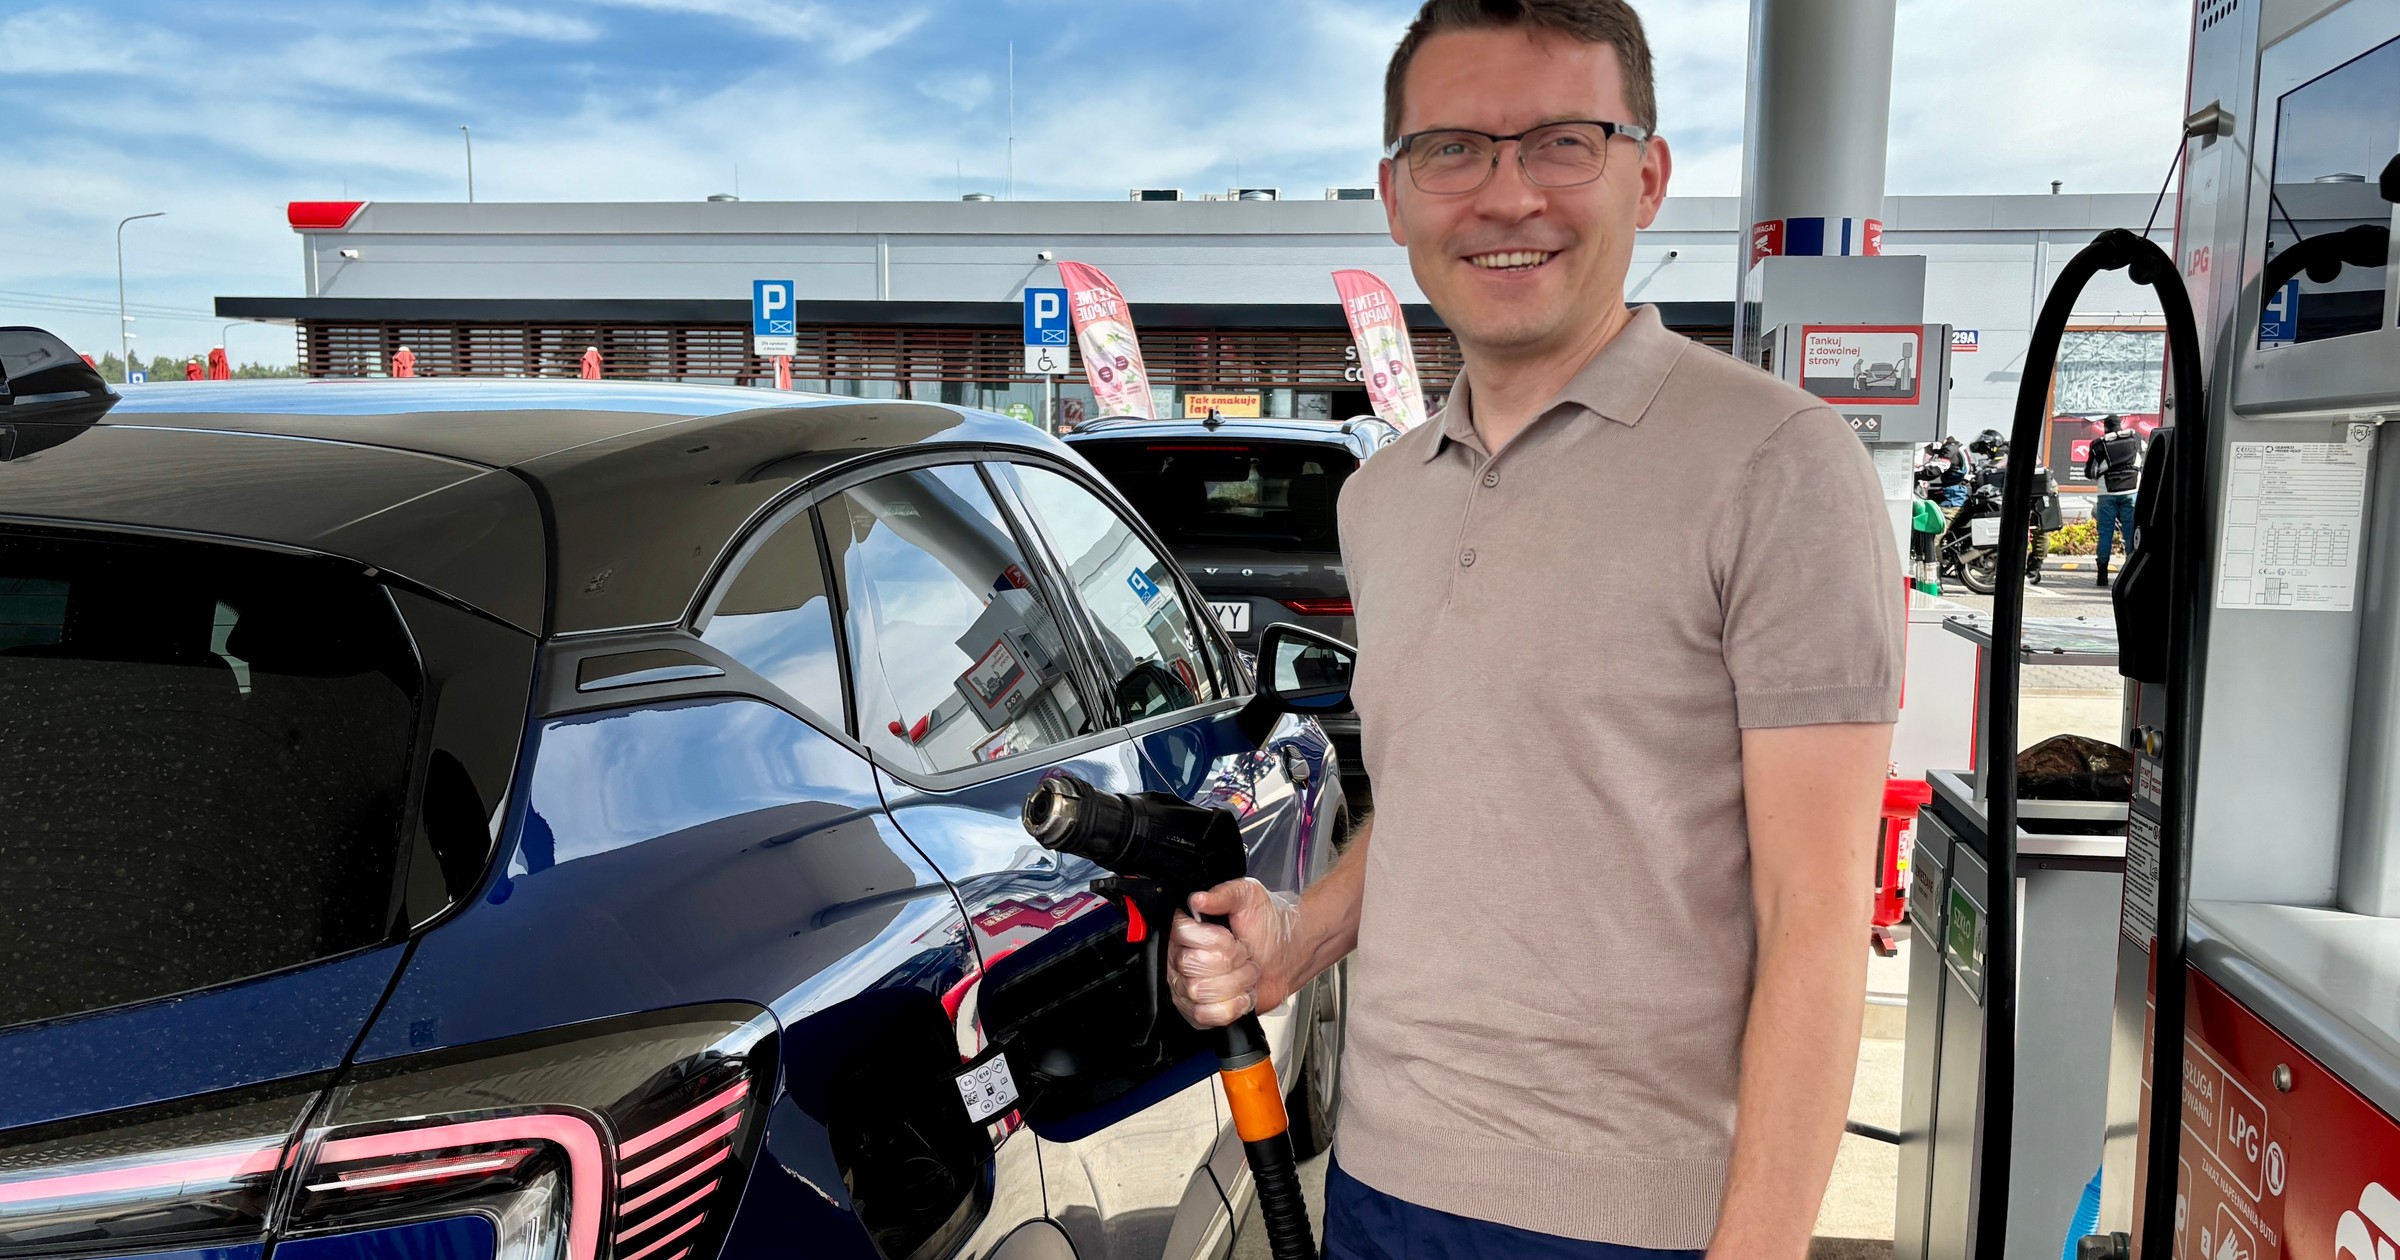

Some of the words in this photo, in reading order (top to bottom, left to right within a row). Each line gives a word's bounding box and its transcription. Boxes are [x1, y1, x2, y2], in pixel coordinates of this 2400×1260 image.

[1753, 223, 1776, 234] UWAGA!
[2188, 246, 2209, 277] LPG
[763, 285, 786, 319] P
[1035, 293, 1059, 328] P
[1810, 337, 1842, 347] Tankuj
[1952, 332, 1976, 344] 29A
[1817, 347, 1860, 357] dowolnej
[1808, 357, 1840, 367] strony
[1189, 396, 1209, 405] Tak
[1211, 396, 1257, 406] smakuje
[1954, 906, 1971, 939] SZKŁO
[979, 1070, 989, 1079] E10
[2183, 1057, 2213, 1103] SŁUGA
[2228, 1106, 2259, 1163] LPG
[2202, 1158, 2220, 1186] ZAKAZ
[2220, 1177, 2259, 1228] NAPEŁNIANIA
[2260, 1219, 2277, 1248] BUTLI
[2203, 1235, 2208, 1248] 2
